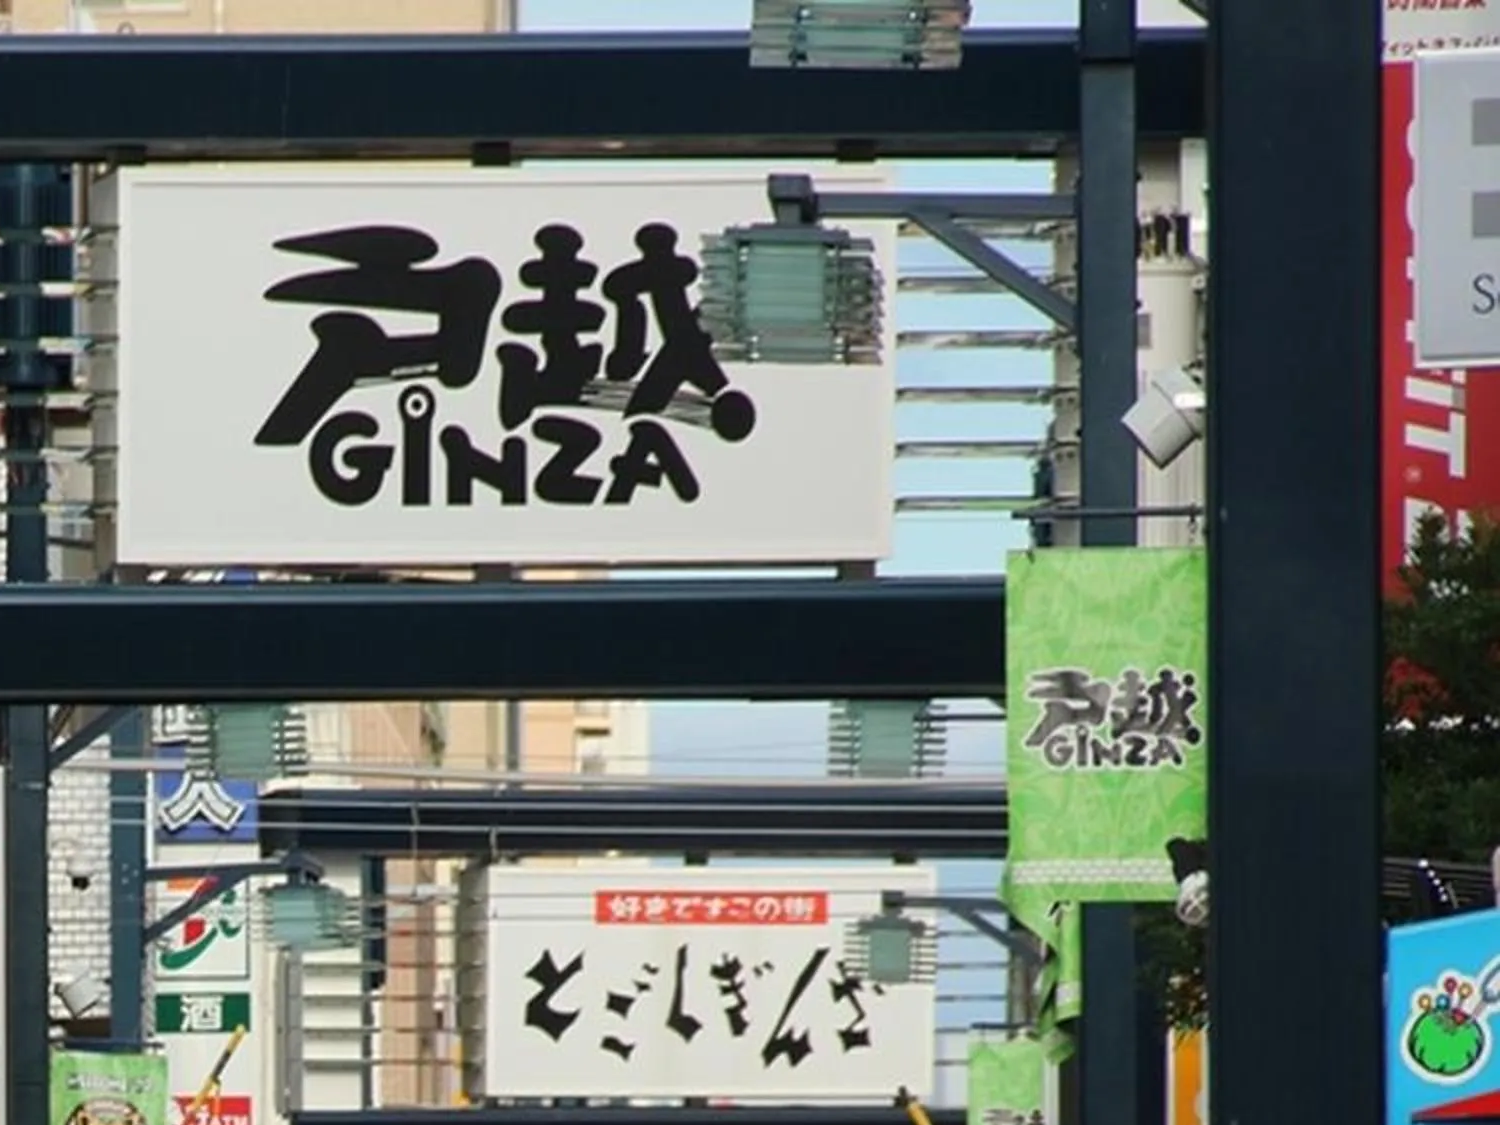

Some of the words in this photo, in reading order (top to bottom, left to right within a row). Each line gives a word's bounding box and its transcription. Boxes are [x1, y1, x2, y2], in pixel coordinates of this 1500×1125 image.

[308, 384, 701, 506] GINZA
[1042, 727, 1184, 768] GINZA
[180, 994, 223, 1031] 酒
[525, 943, 887, 1068] とごしぎんざ
